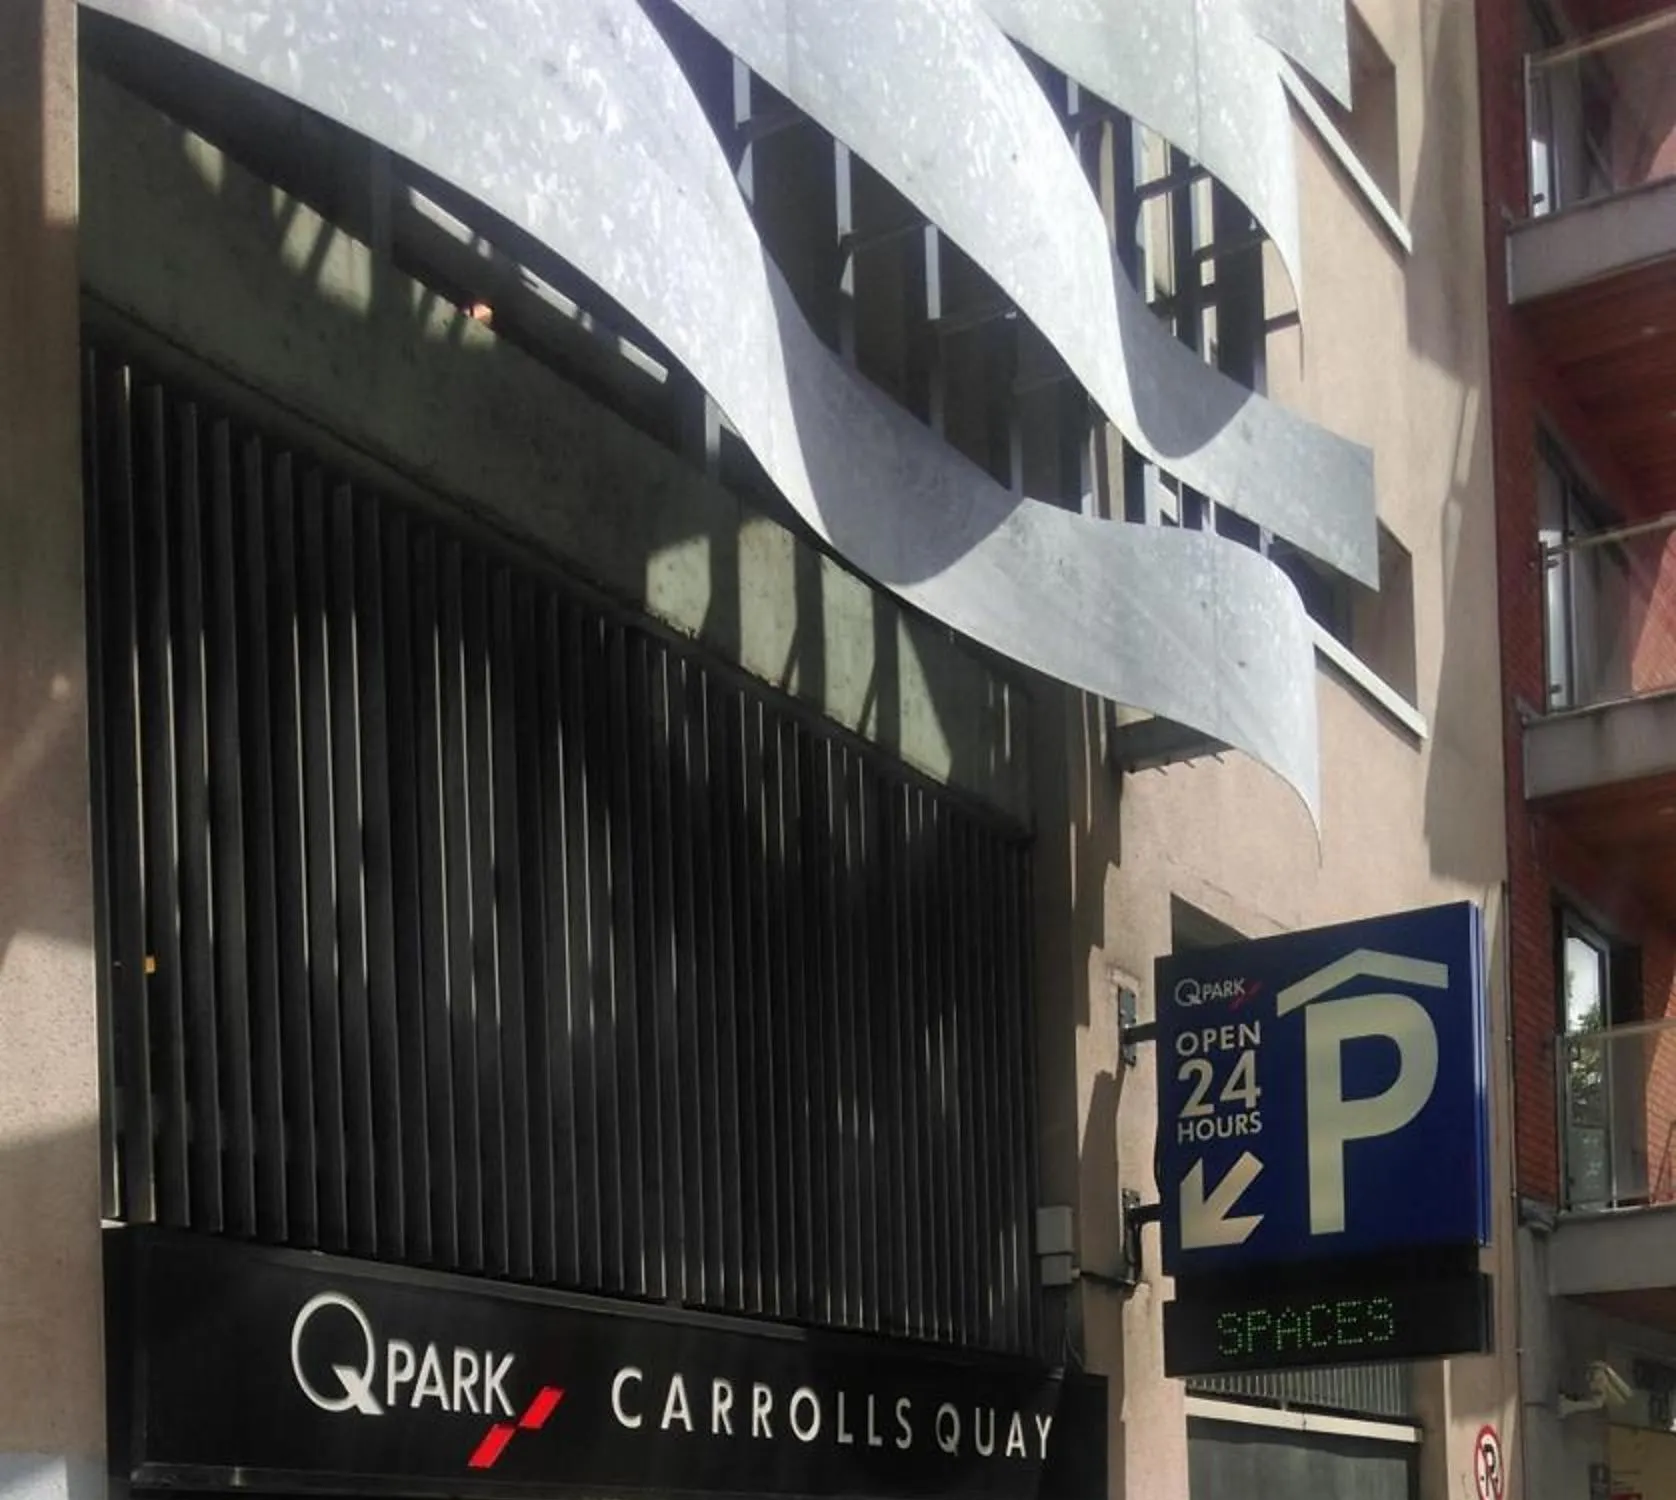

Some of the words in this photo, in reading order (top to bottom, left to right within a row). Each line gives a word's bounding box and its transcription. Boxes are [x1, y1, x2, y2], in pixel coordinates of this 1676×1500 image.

[1176, 1021, 1261, 1056] OPEN
[1177, 1050, 1262, 1118] 24
[1305, 993, 1439, 1235] P
[1177, 1111, 1263, 1144] HOURS
[1216, 1297, 1395, 1356] SPACES
[611, 1365, 913, 1450] CARROLLS
[935, 1401, 1054, 1460] QUAY
